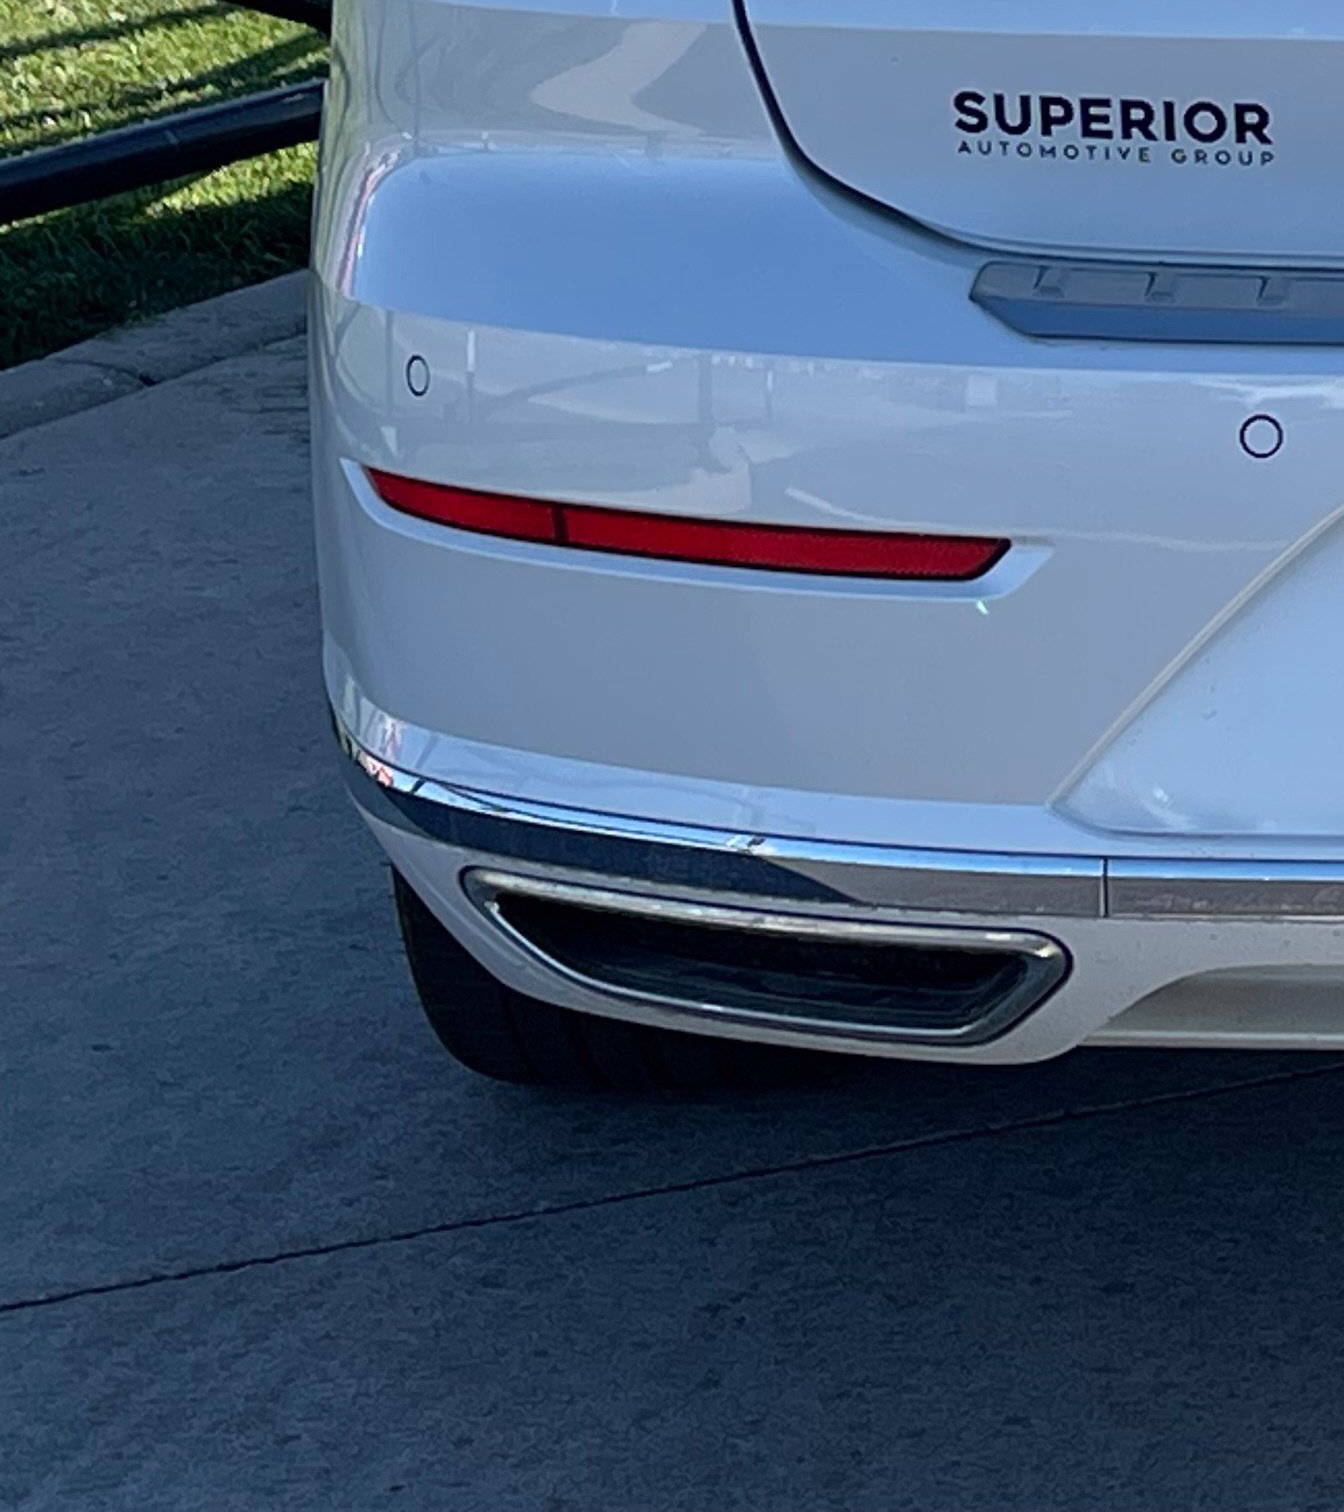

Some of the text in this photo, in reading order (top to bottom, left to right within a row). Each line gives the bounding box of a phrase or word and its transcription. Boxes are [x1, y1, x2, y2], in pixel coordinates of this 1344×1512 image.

[952, 90, 1273, 145] SUPERIOR
[957, 139, 1276, 167] AUTOMOTIVE GROUP
